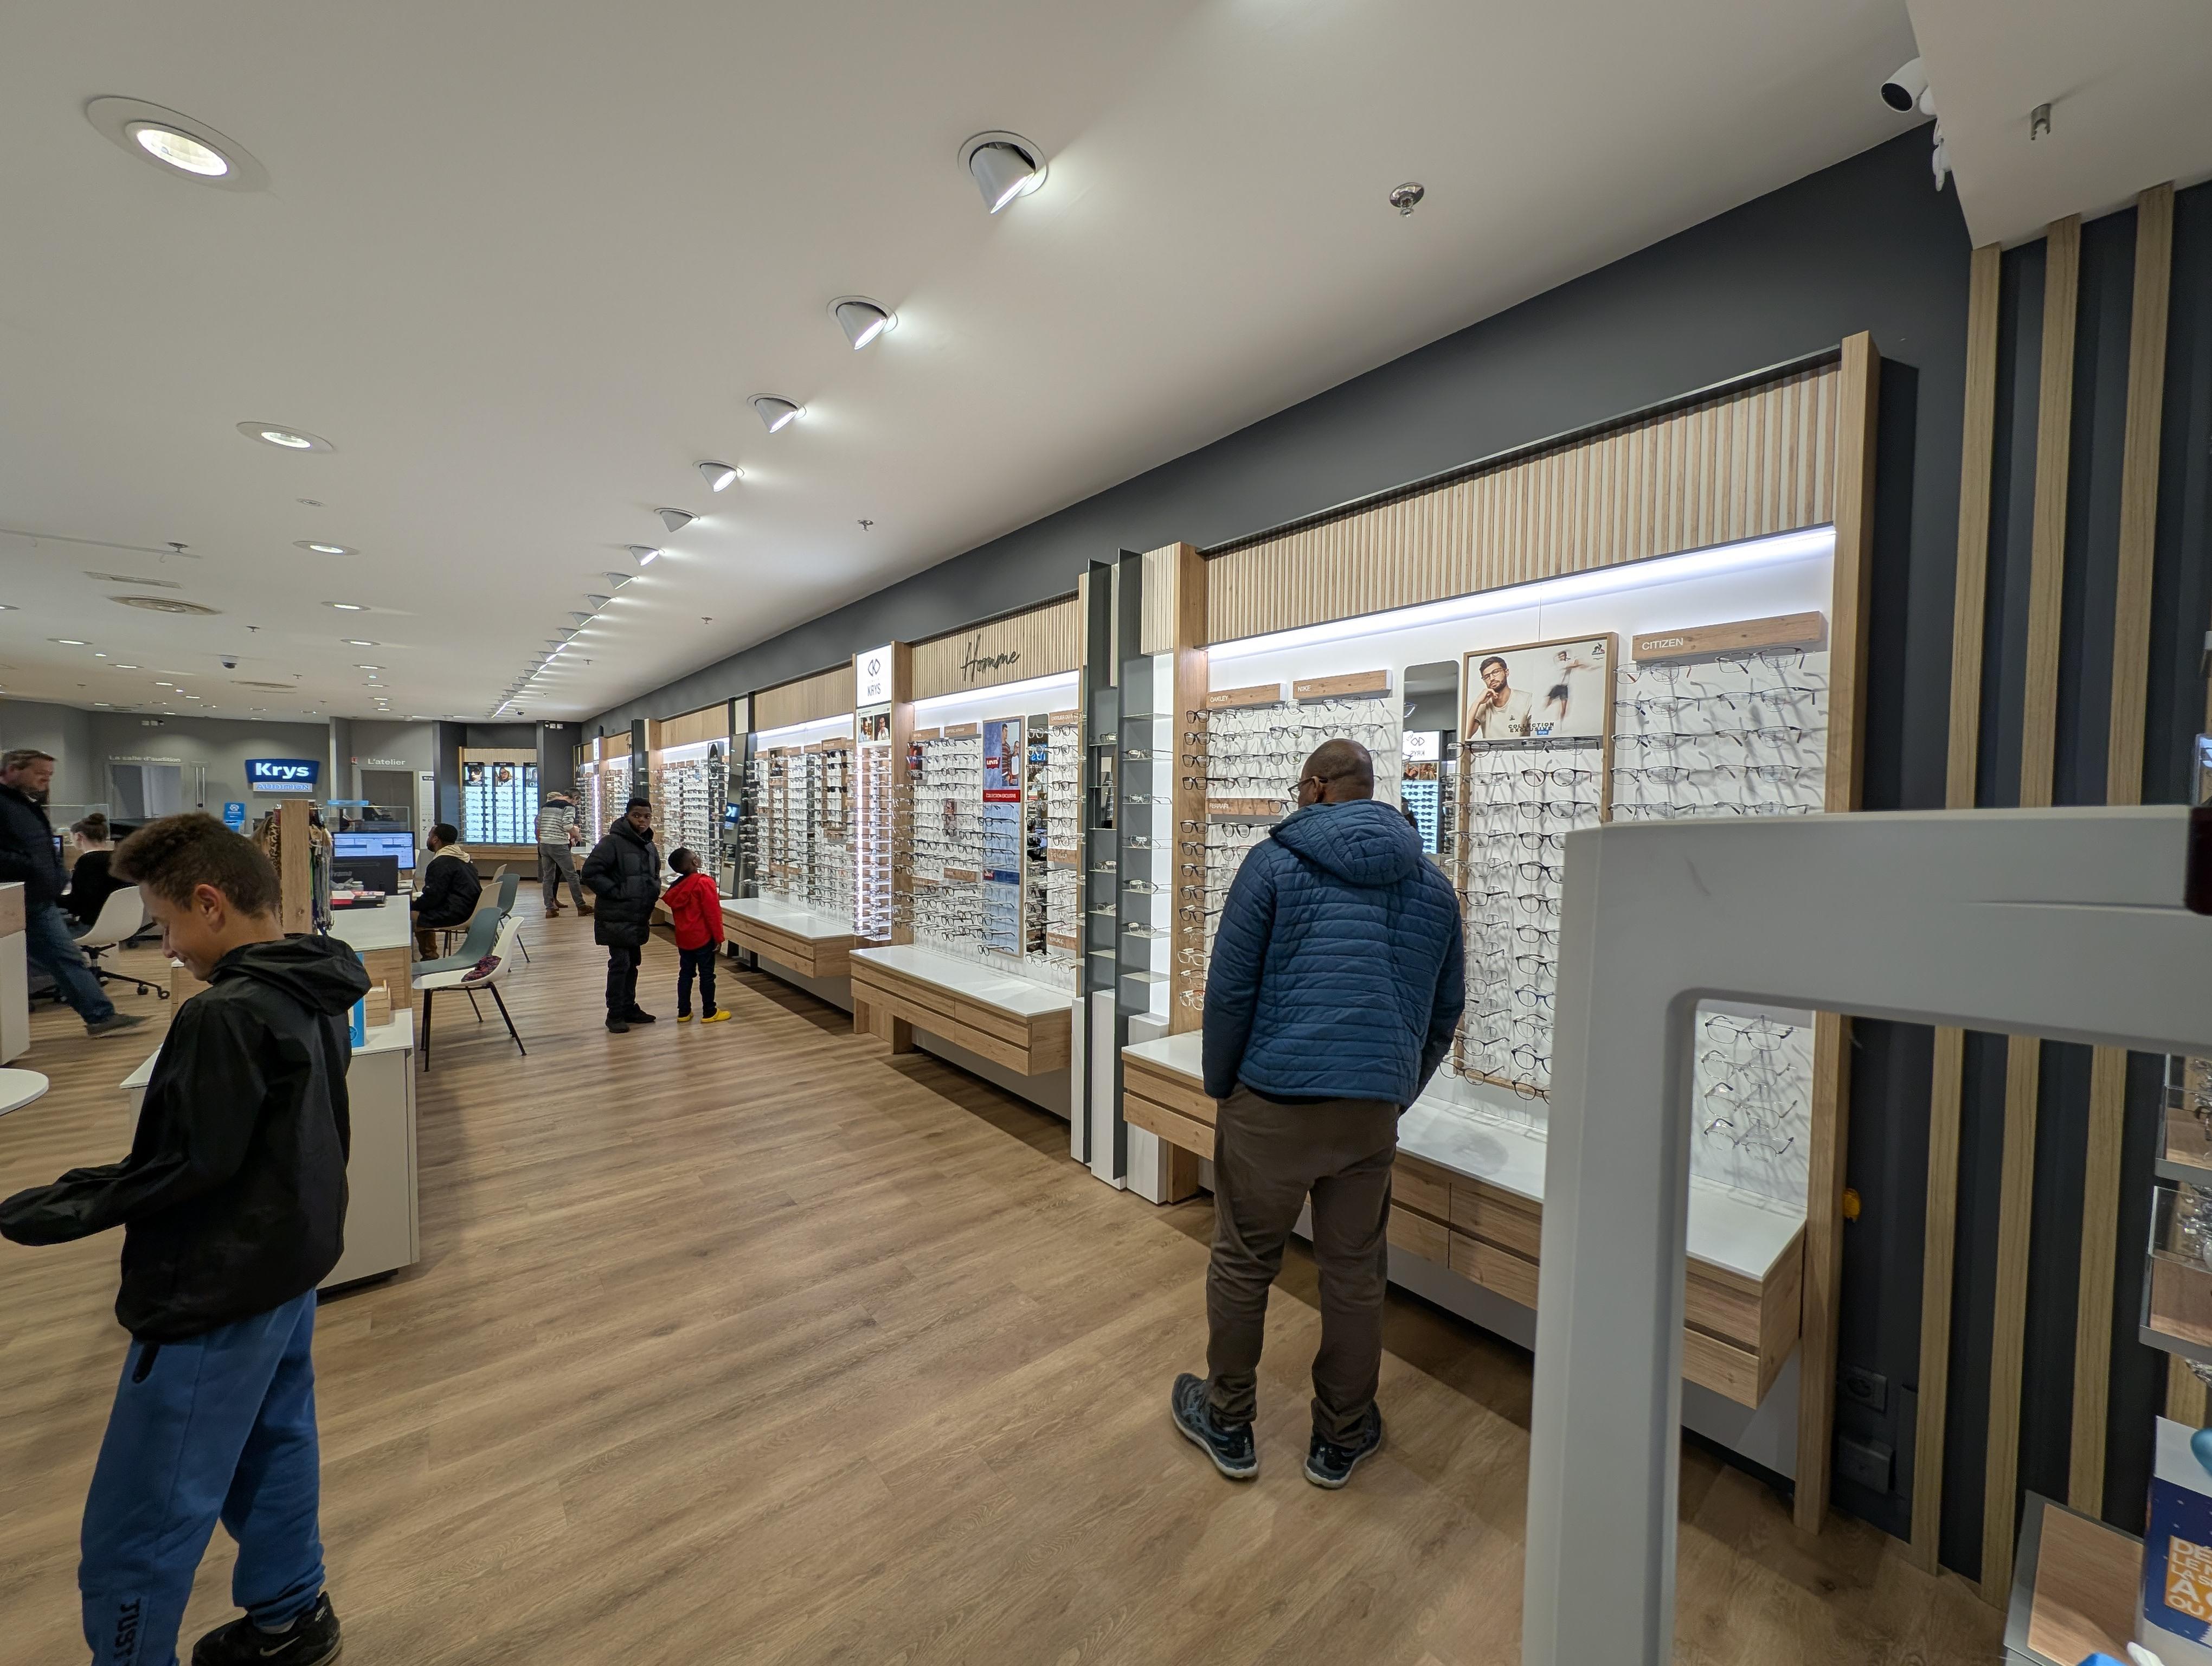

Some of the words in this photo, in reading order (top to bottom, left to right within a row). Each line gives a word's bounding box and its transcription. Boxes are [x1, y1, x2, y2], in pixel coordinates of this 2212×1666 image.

[1642, 638, 1683, 650] CITIZEN
[960, 633, 1020, 682] Homme
[867, 683, 881, 696] KRYS
[255, 762, 310, 779] Krys
